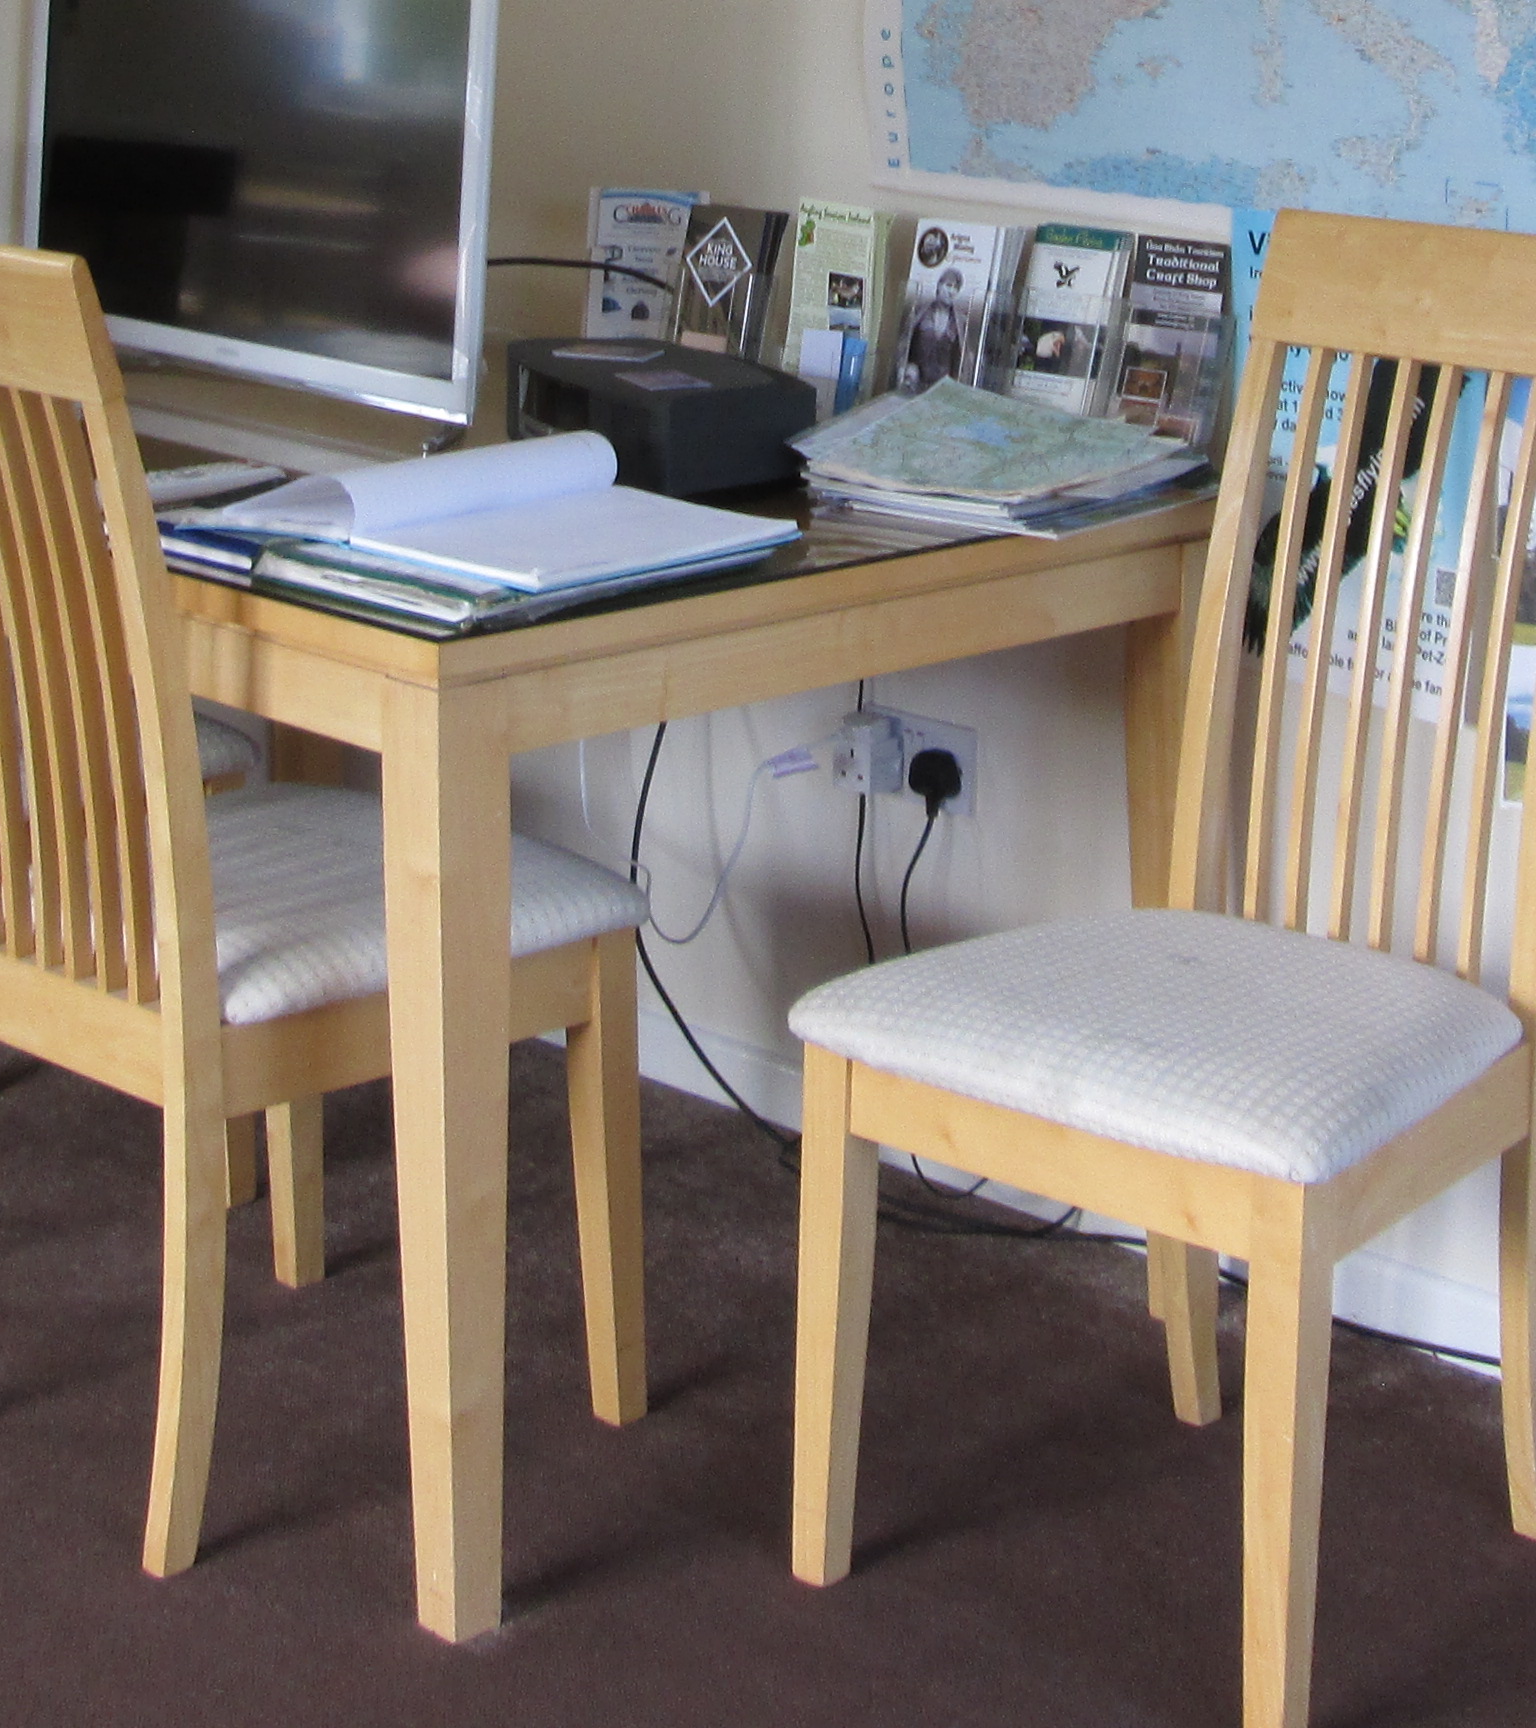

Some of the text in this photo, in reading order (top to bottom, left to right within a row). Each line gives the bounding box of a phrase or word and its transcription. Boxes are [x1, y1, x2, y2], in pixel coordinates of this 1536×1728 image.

[879, 28, 901, 168] Europe
[706, 242, 733, 257] KING
[698, 255, 738, 271] HOUSE
[1146, 252, 1221, 273] Traditional
[1145, 267, 1218, 290] Craft Shop
